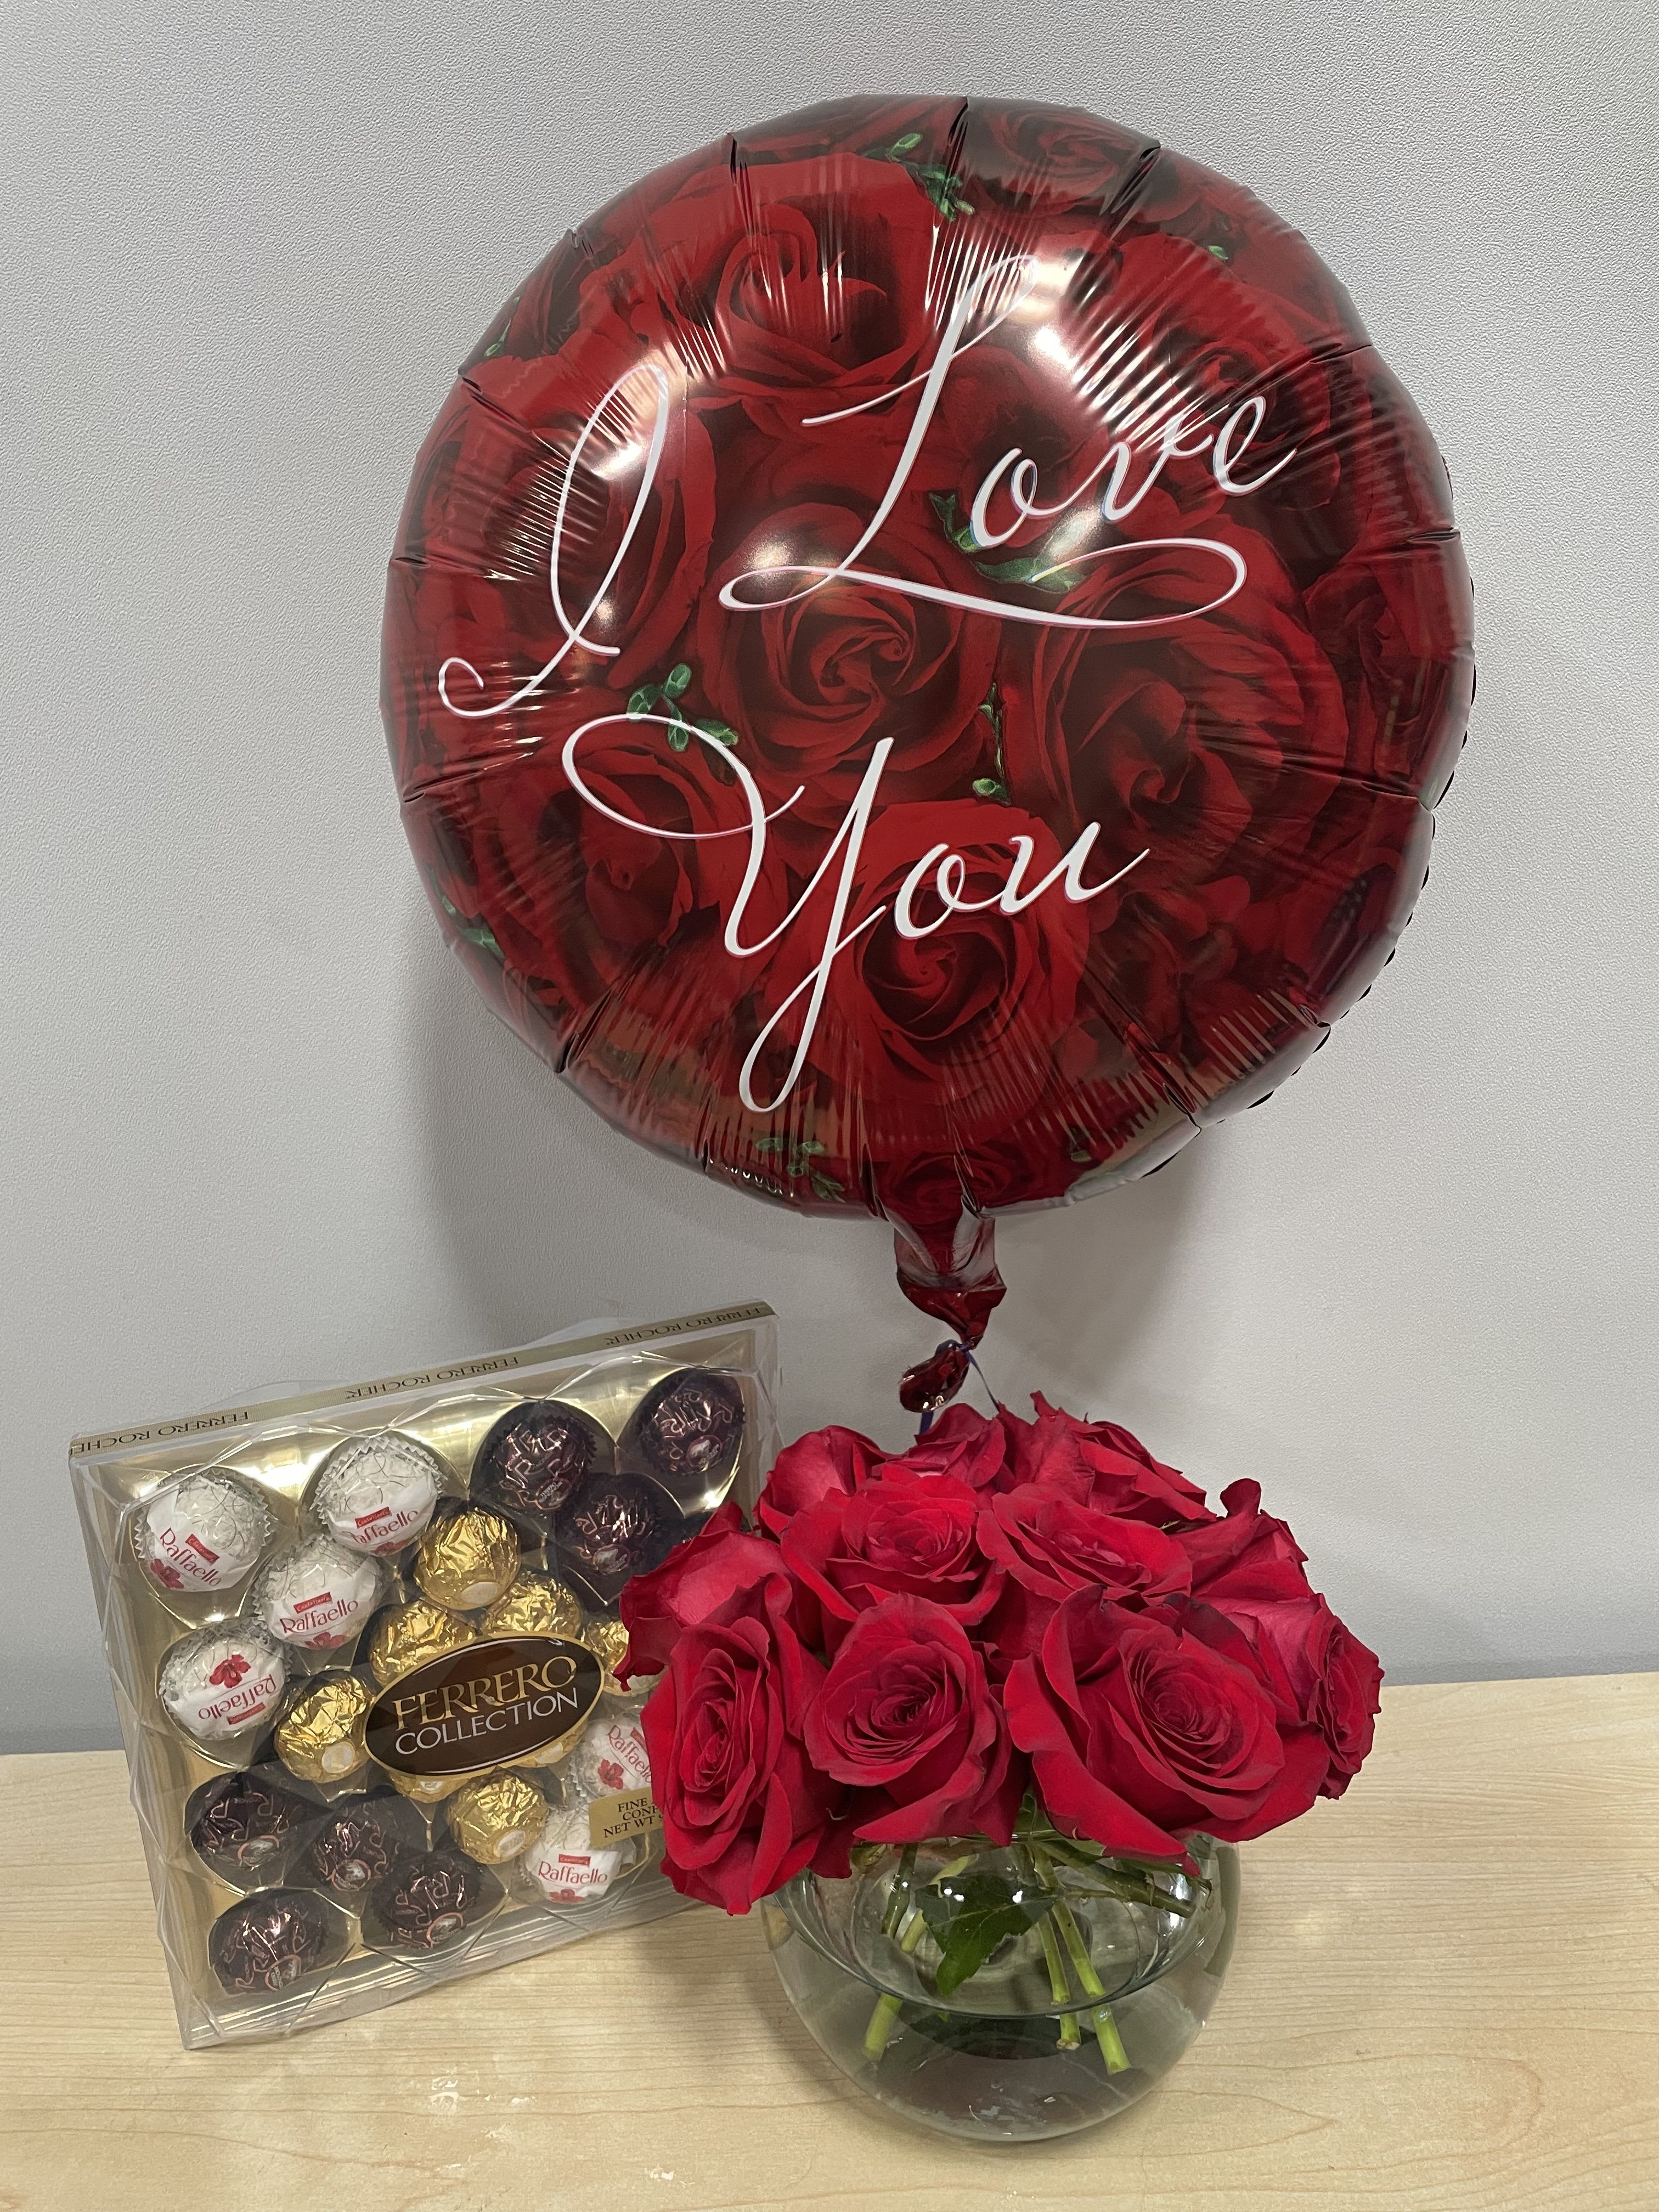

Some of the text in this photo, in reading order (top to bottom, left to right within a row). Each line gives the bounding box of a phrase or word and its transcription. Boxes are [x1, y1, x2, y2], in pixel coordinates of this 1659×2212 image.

[439, 255, 1298, 718] I Love
[562, 712, 1149, 1113] You
[347, 1357, 518, 1400] FERRERO ROCHER
[158, 1411, 249, 1436] FERRERO
[160, 1527, 221, 1587] Raffaello
[280, 1599, 358, 1634] Raffaello
[199, 1674, 276, 1720] Raffaello
[392, 1656, 577, 1731] FERRERO
[395, 1688, 578, 1755] COLLECTION
[603, 1821, 631, 1838] NET
[634, 1815, 656, 1829] WT
[618, 1797, 648, 1813] FINE
[538, 1860, 608, 1884] Raffaello
